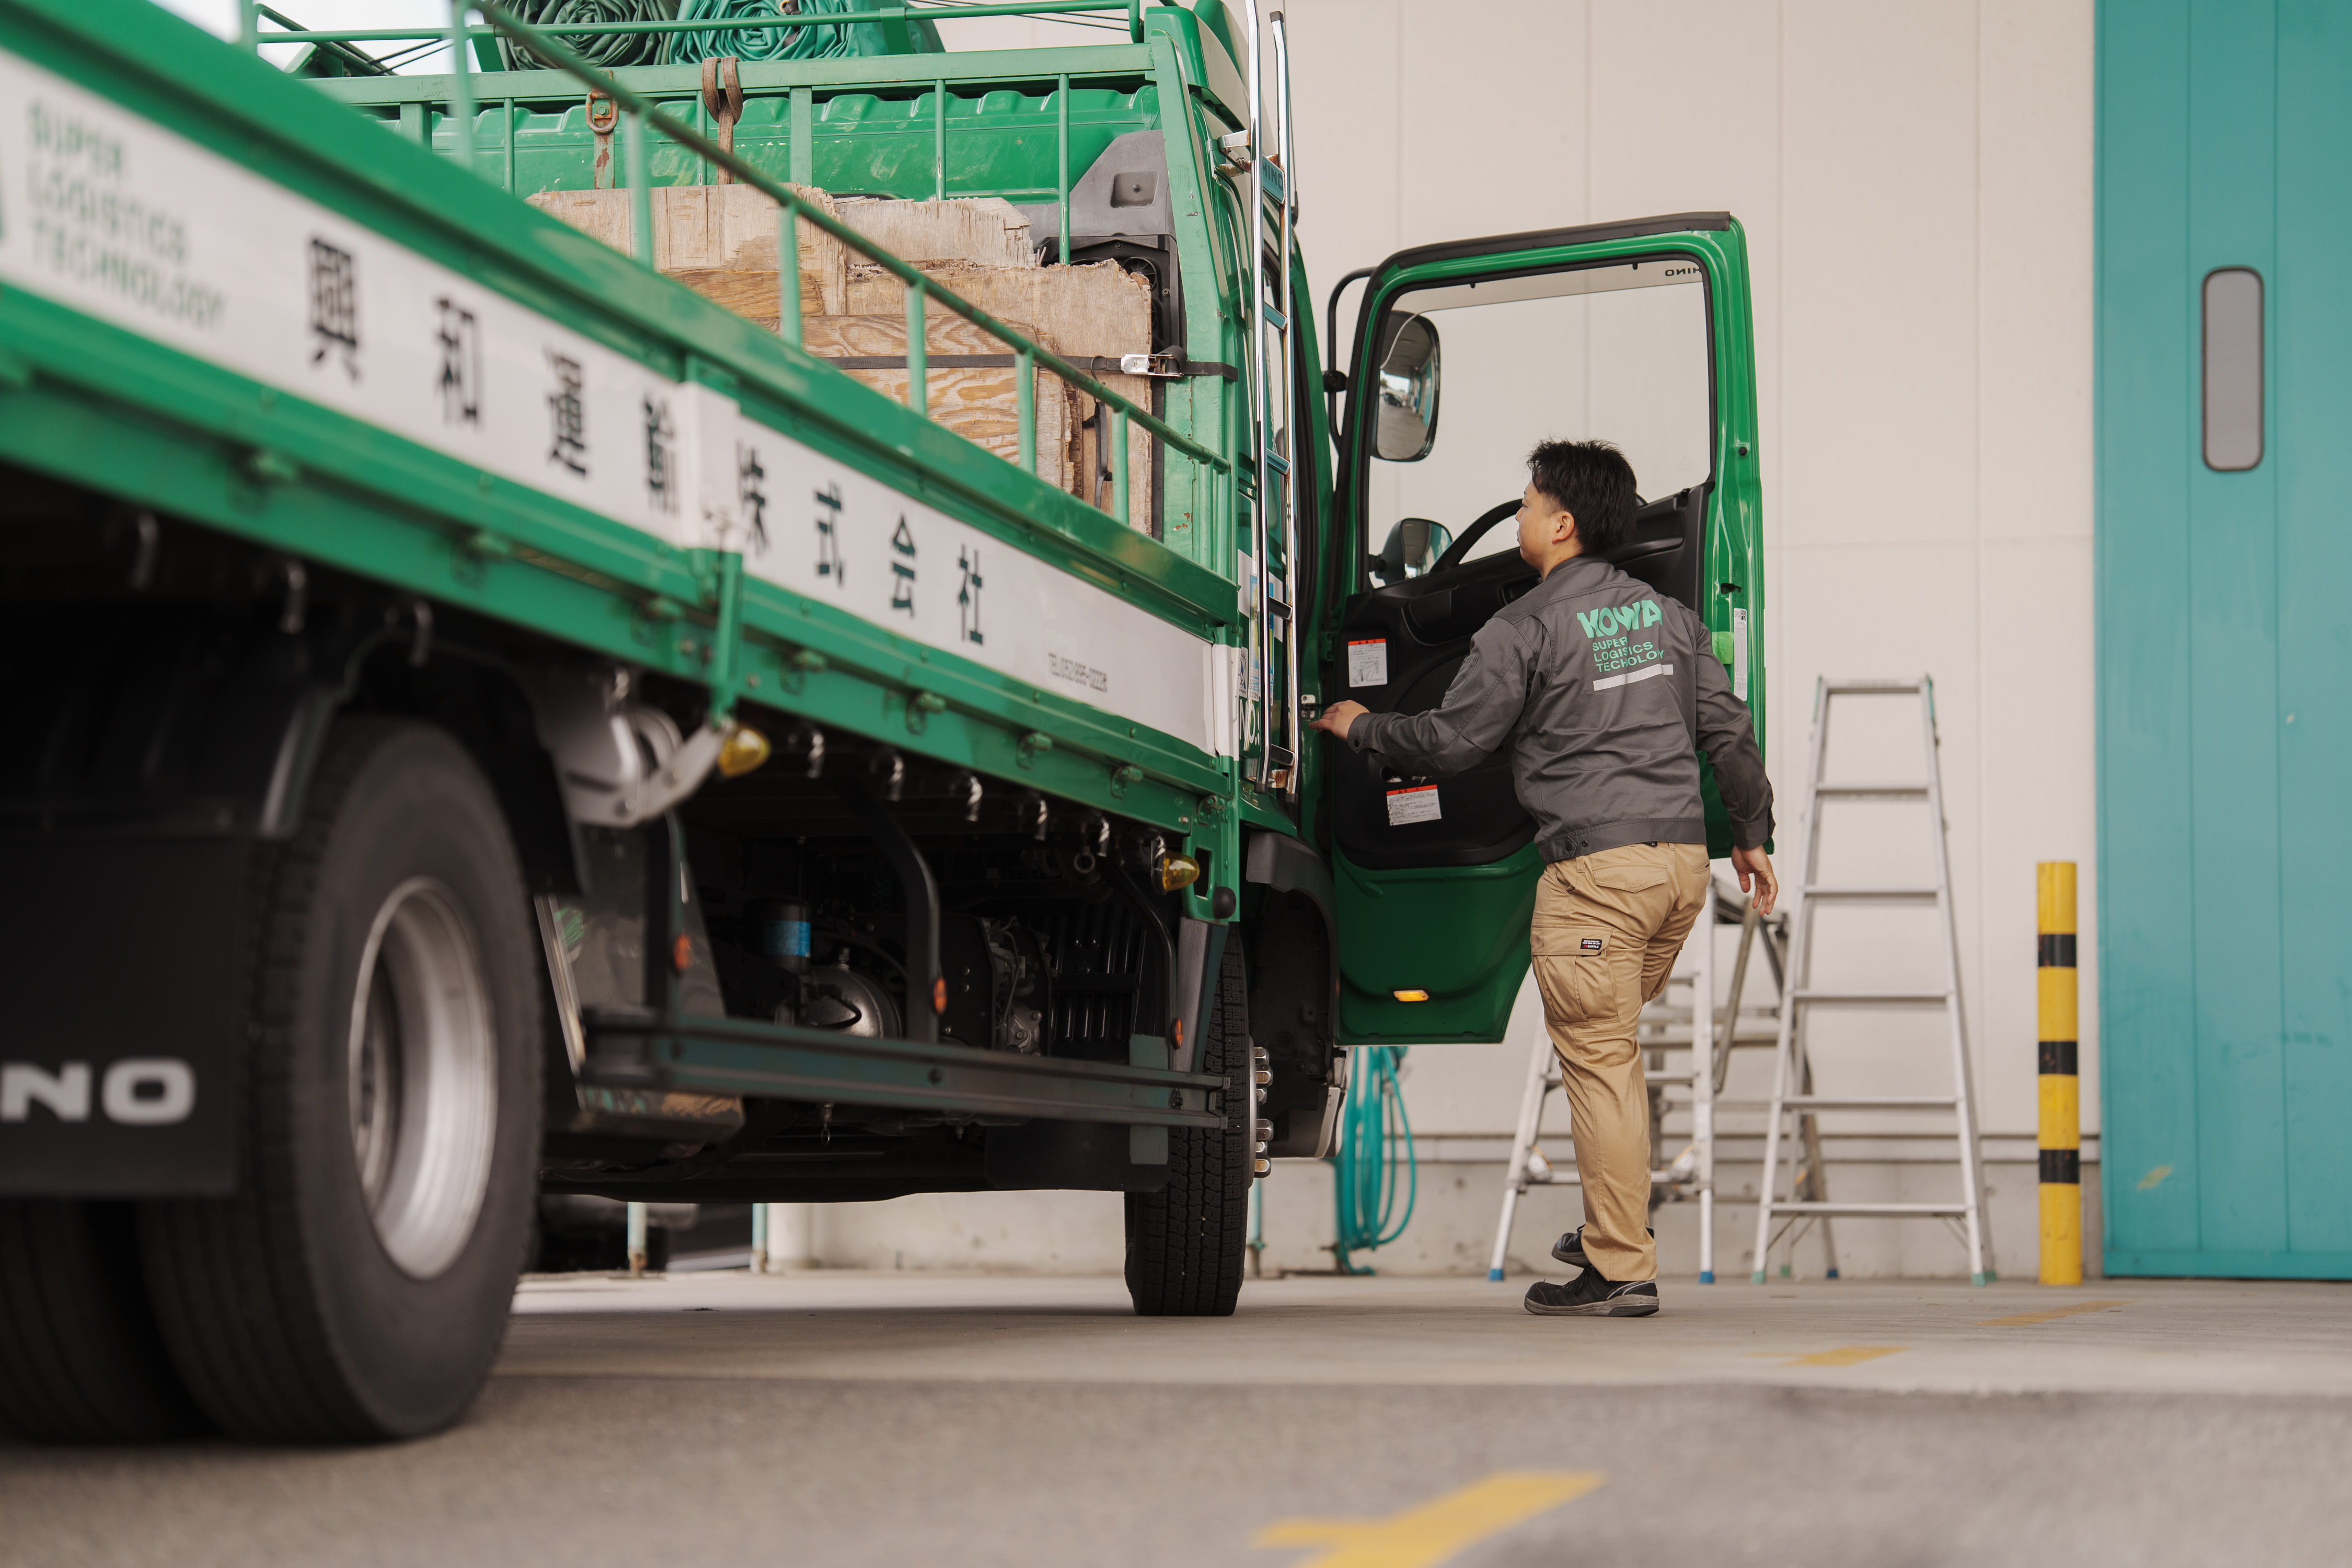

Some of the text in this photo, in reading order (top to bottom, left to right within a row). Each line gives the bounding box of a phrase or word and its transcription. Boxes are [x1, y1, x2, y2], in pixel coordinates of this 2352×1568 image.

[27, 99, 124, 179] SUPER
[27, 159, 187, 264] LOGISTICS
[32, 218, 225, 329] TECHNOLOGY
[1576, 599, 1663, 639] KOWA
[1592, 636, 1628, 651] SUPER
